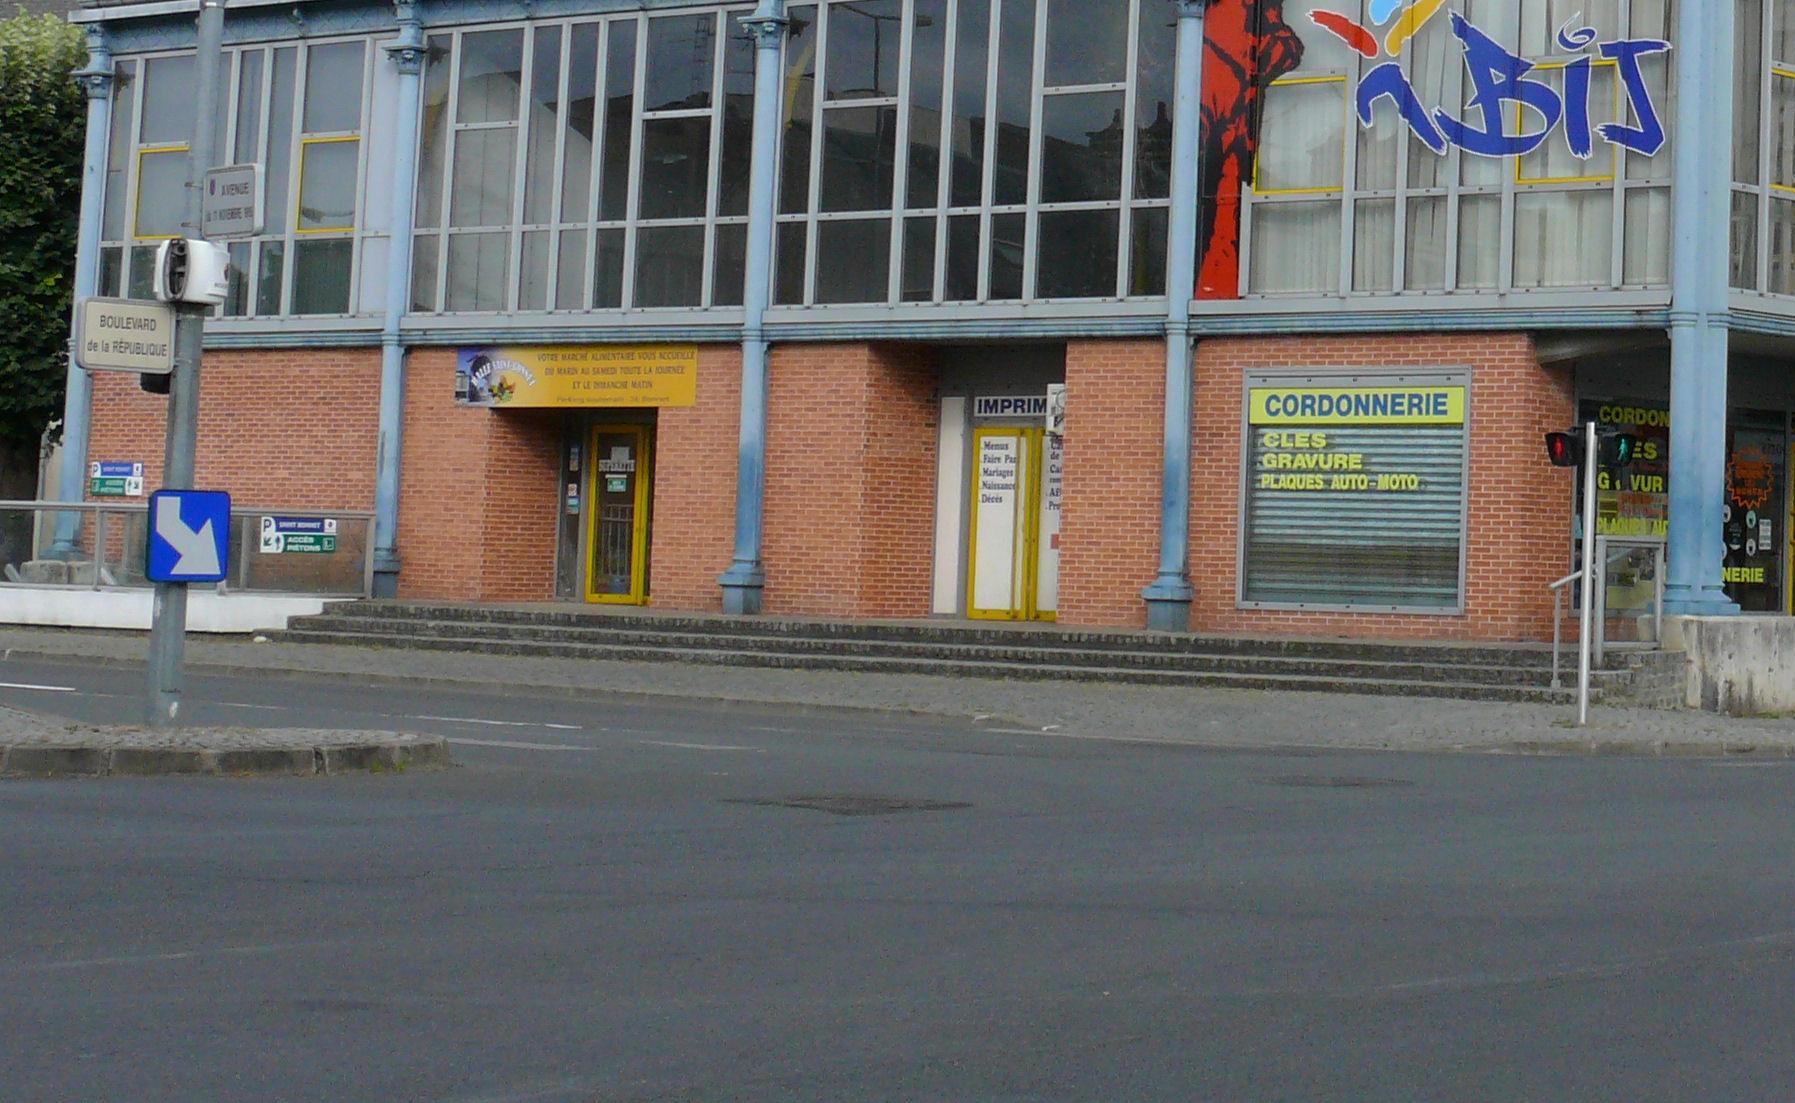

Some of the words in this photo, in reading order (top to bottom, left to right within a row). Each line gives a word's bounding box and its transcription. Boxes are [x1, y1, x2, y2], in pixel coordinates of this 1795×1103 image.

[221, 182, 249, 196] AVENUE
[99, 314, 157, 331] BOULEVARD
[87, 340, 98, 352] de
[101, 341, 110, 352] la
[112, 339, 168, 356] RÉPUBLIQUE
[638, 351, 656, 361] VOUS
[644, 366, 653, 375] LA
[631, 380, 653, 389] MATIN
[1264, 393, 1449, 417] CORDONNERIE
[983, 441, 1009, 451] Menus
[1263, 433, 1327, 448] CLES
[983, 454, 1001, 464] Faire
[1262, 453, 1363, 469] GRAVURE
[982, 467, 1013, 479] Mariages
[1260, 473, 1324, 490] PLAQUES
[263, 519, 272, 532] P
